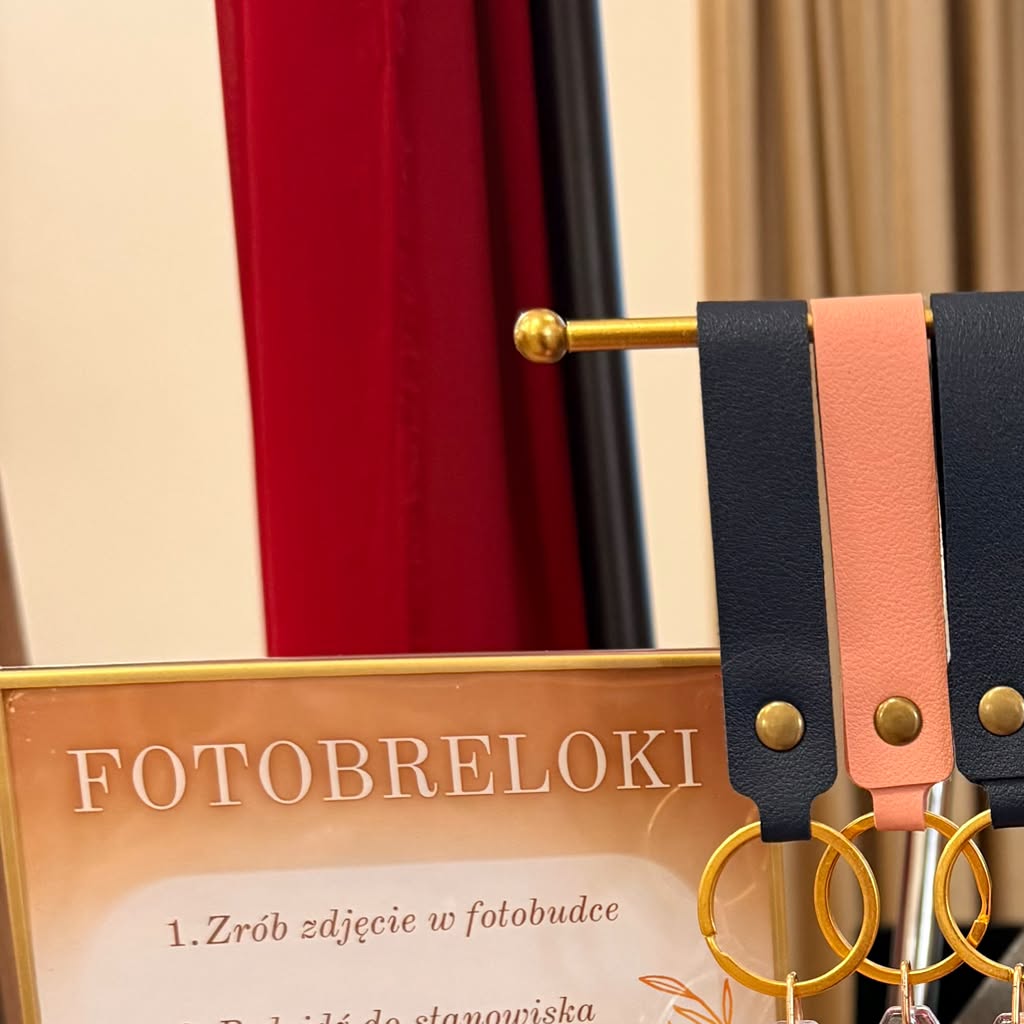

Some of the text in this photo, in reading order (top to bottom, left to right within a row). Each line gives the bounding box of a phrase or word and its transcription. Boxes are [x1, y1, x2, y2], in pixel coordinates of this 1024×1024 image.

[65, 727, 704, 815] FOTOBRELOKI
[300, 905, 417, 947] zdjęcie
[427, 911, 456, 932] w
[465, 894, 619, 938] fotobudce
